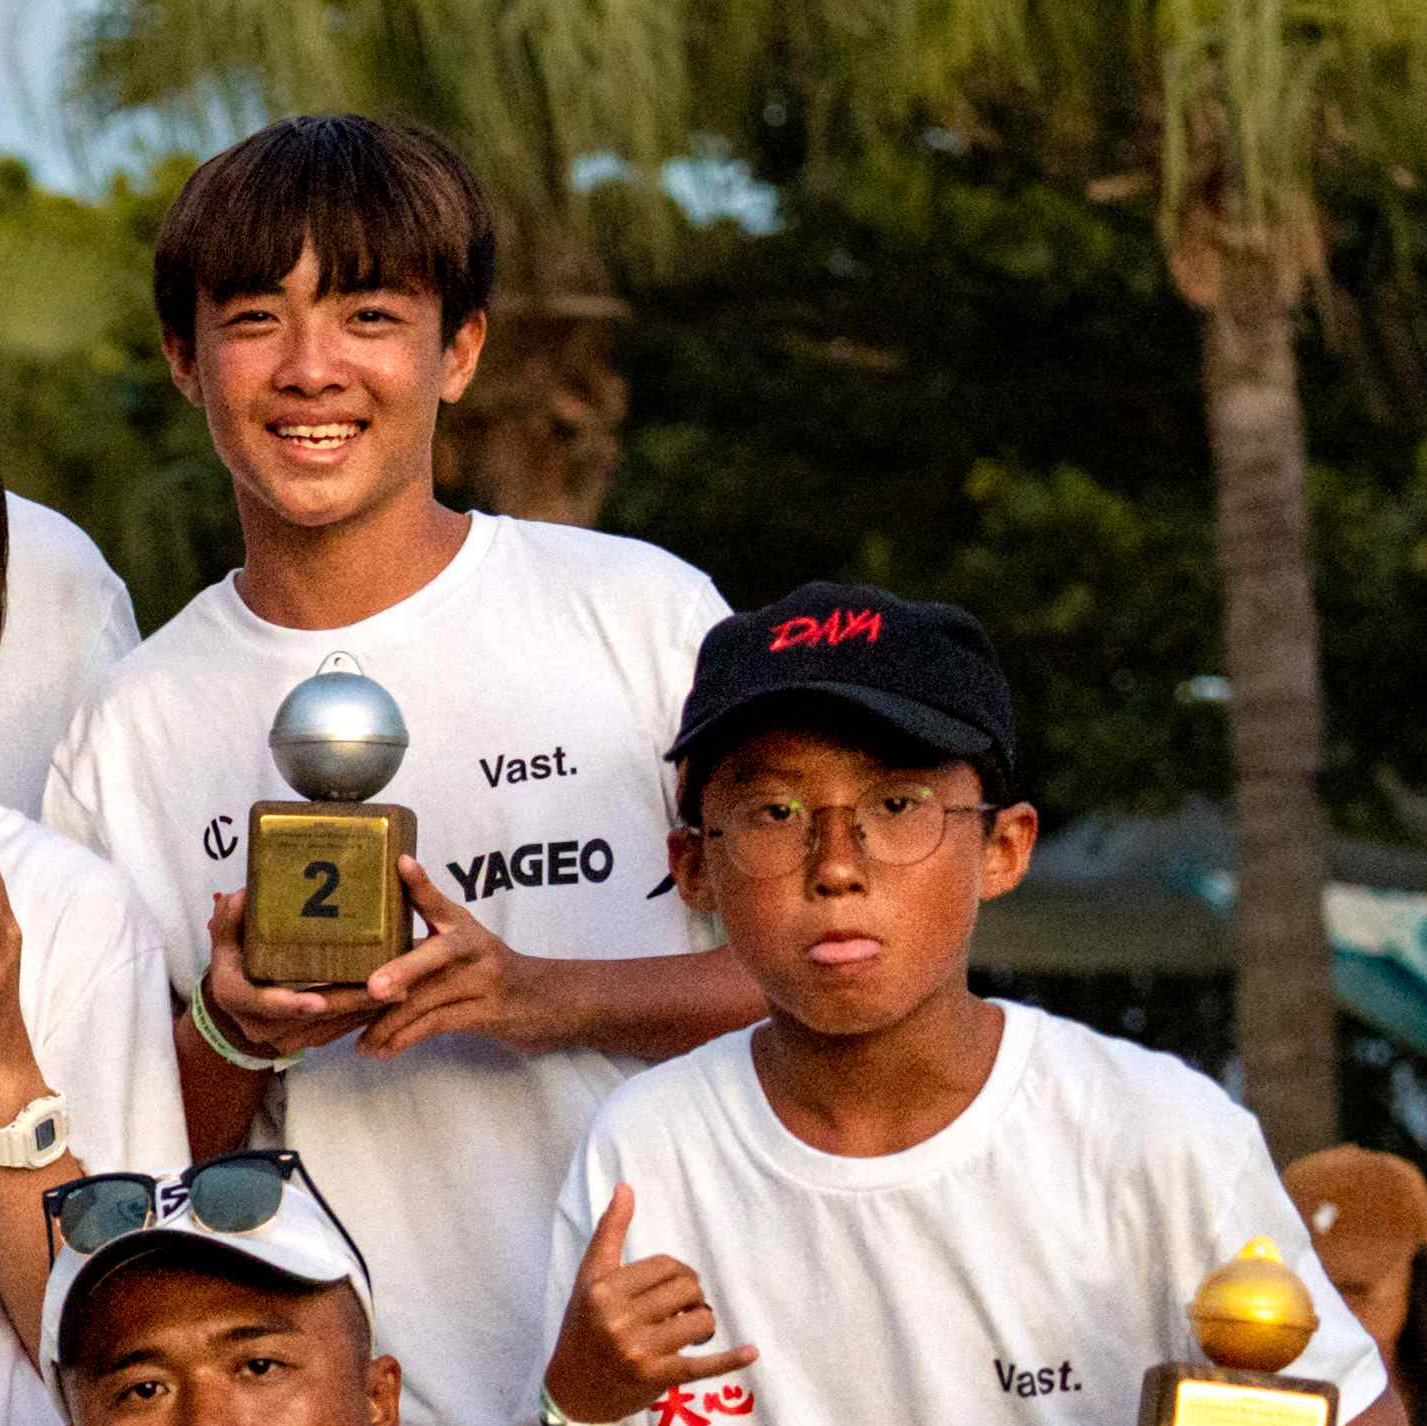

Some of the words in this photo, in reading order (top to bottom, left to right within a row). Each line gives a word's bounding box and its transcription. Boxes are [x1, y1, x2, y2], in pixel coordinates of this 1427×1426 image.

[480, 745, 578, 789] Vast.
[299, 861, 340, 918] 2
[447, 838, 613, 901] YAGEO
[995, 1358, 1083, 1398] Vast.
